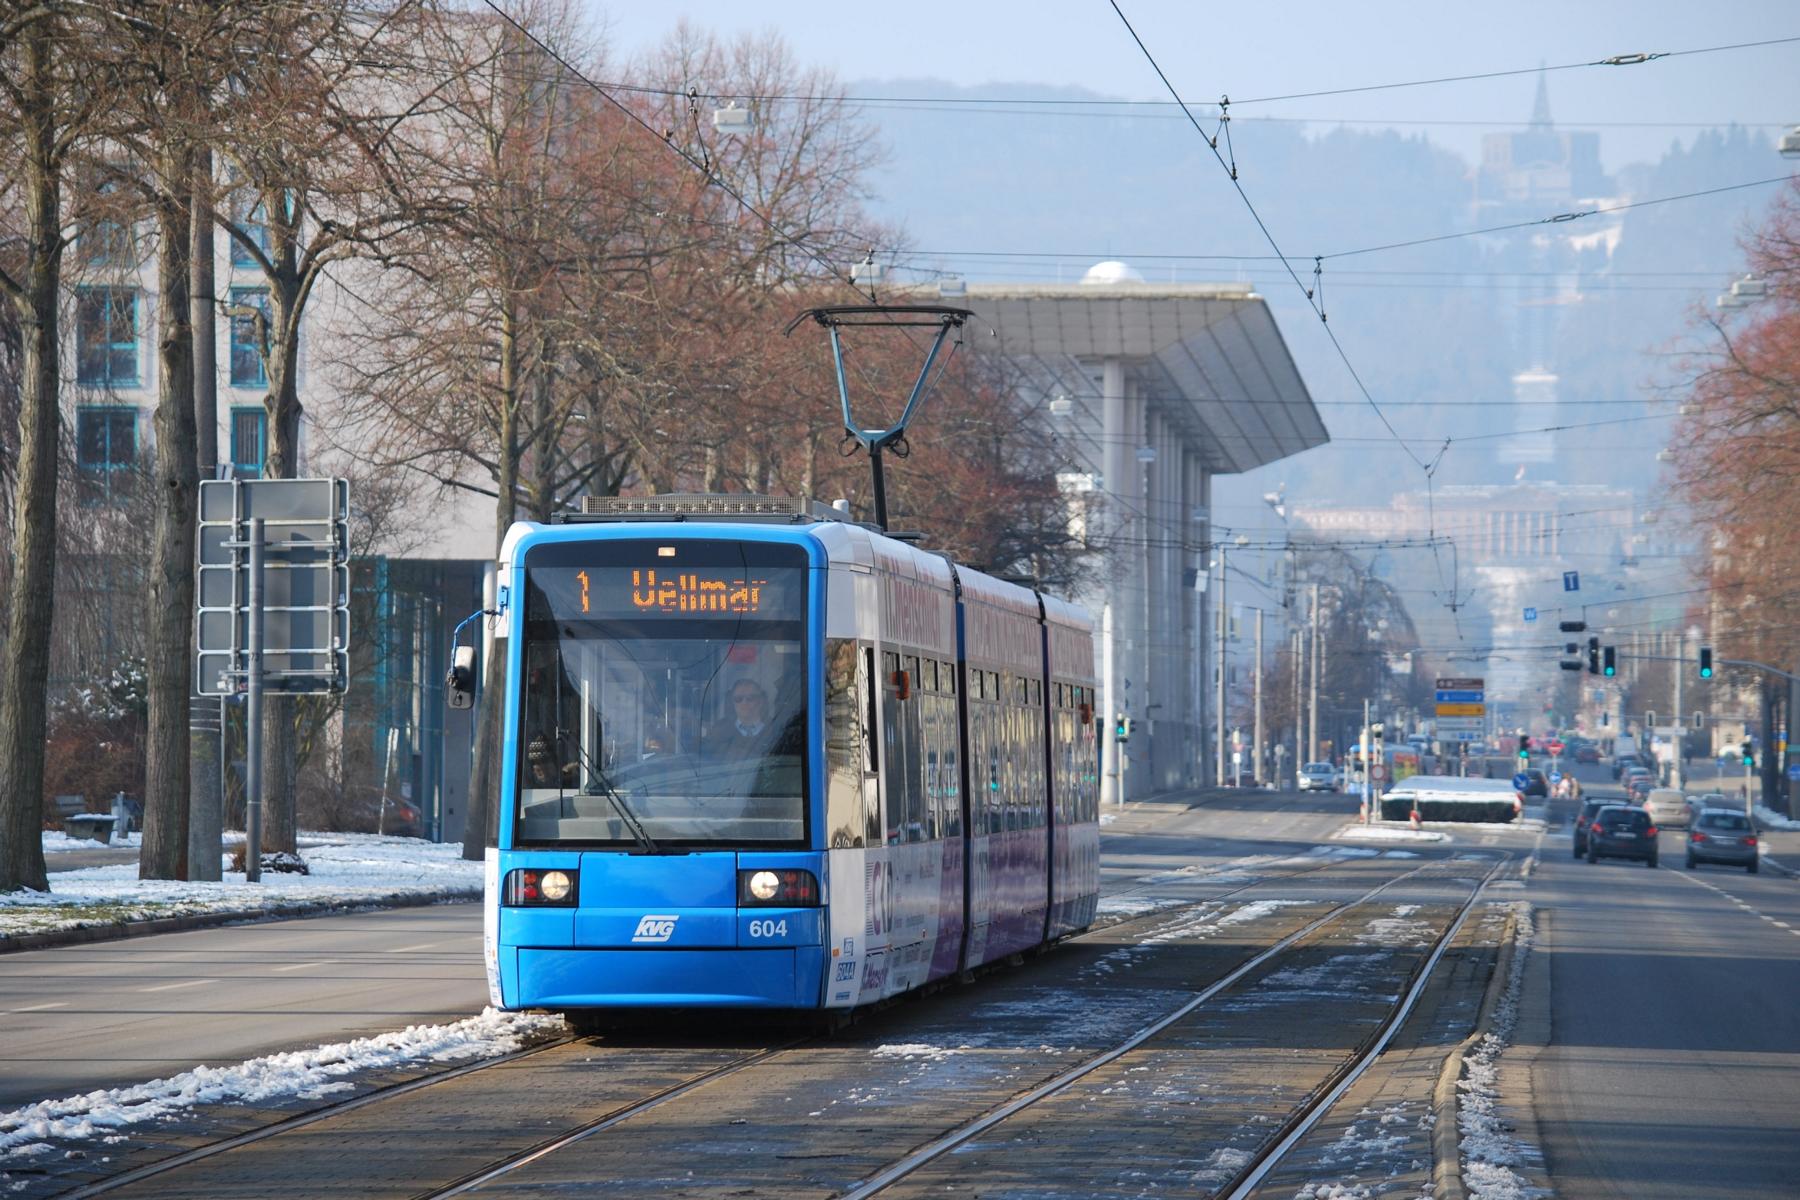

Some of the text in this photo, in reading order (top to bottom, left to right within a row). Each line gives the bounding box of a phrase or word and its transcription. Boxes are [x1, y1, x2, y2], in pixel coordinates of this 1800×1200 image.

[576, 569, 589, 612] 1
[633, 918, 677, 940] KVG
[749, 919, 788, 938] 604
